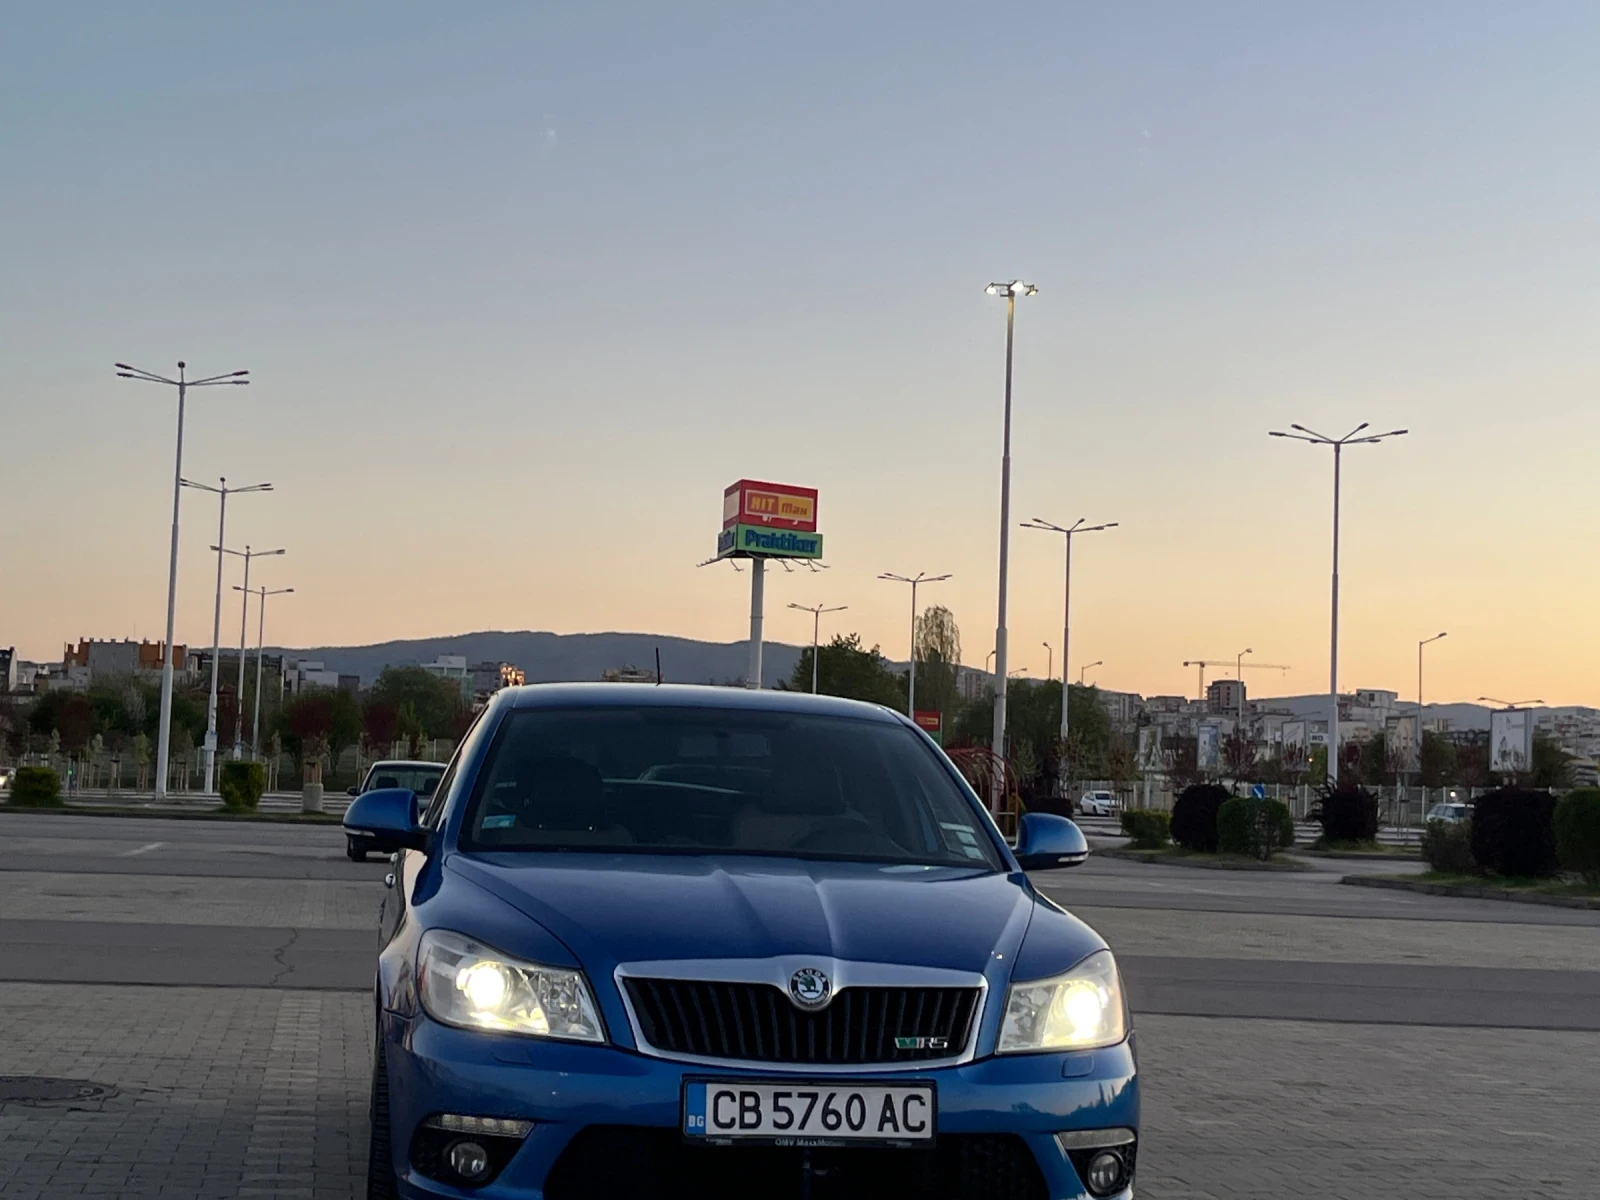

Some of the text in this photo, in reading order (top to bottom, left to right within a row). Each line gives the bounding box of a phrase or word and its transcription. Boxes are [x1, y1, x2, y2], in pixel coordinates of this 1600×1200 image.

[751, 496, 776, 511] HIT
[745, 529, 818, 553] Praktiker
[688, 1115, 704, 1127] BG
[712, 1090, 927, 1133] CB 5760 AC
